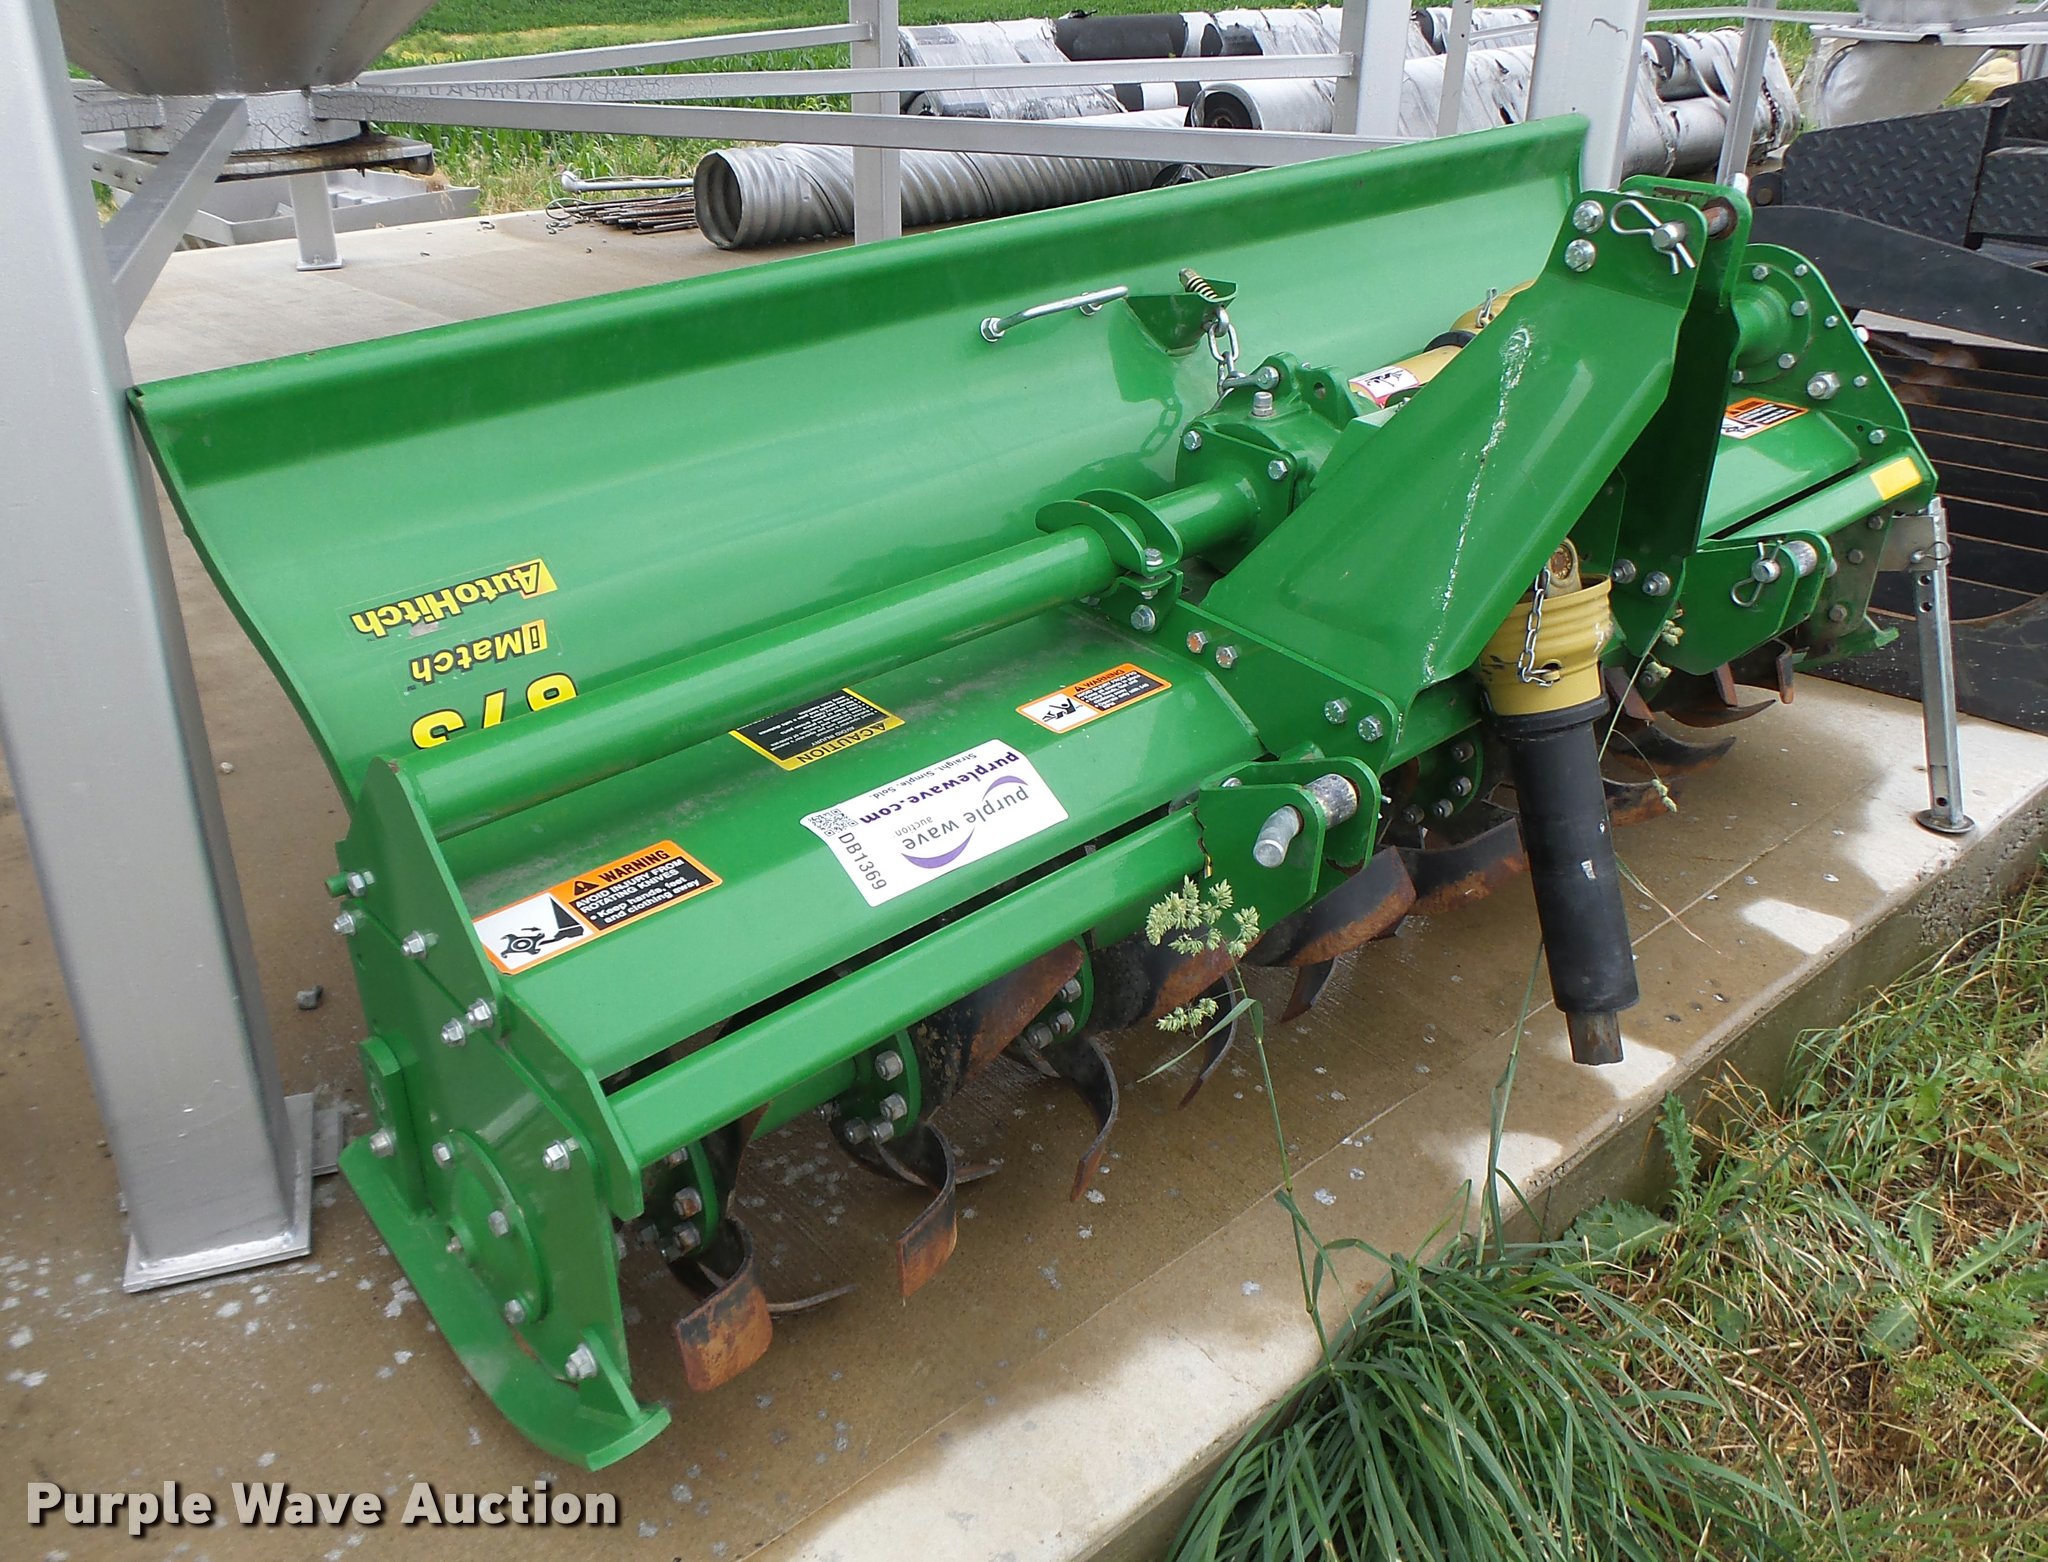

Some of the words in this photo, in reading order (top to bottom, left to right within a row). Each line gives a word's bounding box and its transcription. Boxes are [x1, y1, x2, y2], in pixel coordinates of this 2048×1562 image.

[350, 562, 541, 638] AutoHitch
[409, 622, 544, 685] iMatch
[797, 727, 874, 764] CAUTION
[859, 751, 1020, 824] purplewave.com
[963, 786, 1030, 824] purple
[896, 816, 933, 837] auction
[902, 819, 960, 850] wave
[575, 889, 609, 908] AVOID
[611, 871, 651, 896] INJURY
[652, 858, 685, 876] FROM
[598, 850, 671, 882] WARNING
[838, 832, 888, 890] DB1369
[580, 885, 638, 914] ROTATING
[639, 869, 680, 890] KNIVES
[600, 902, 628, 918] Keep
[664, 876, 688, 889] feet
[604, 910, 627, 924] and
[628, 892, 673, 914] clothing
[673, 878, 700, 895] away
